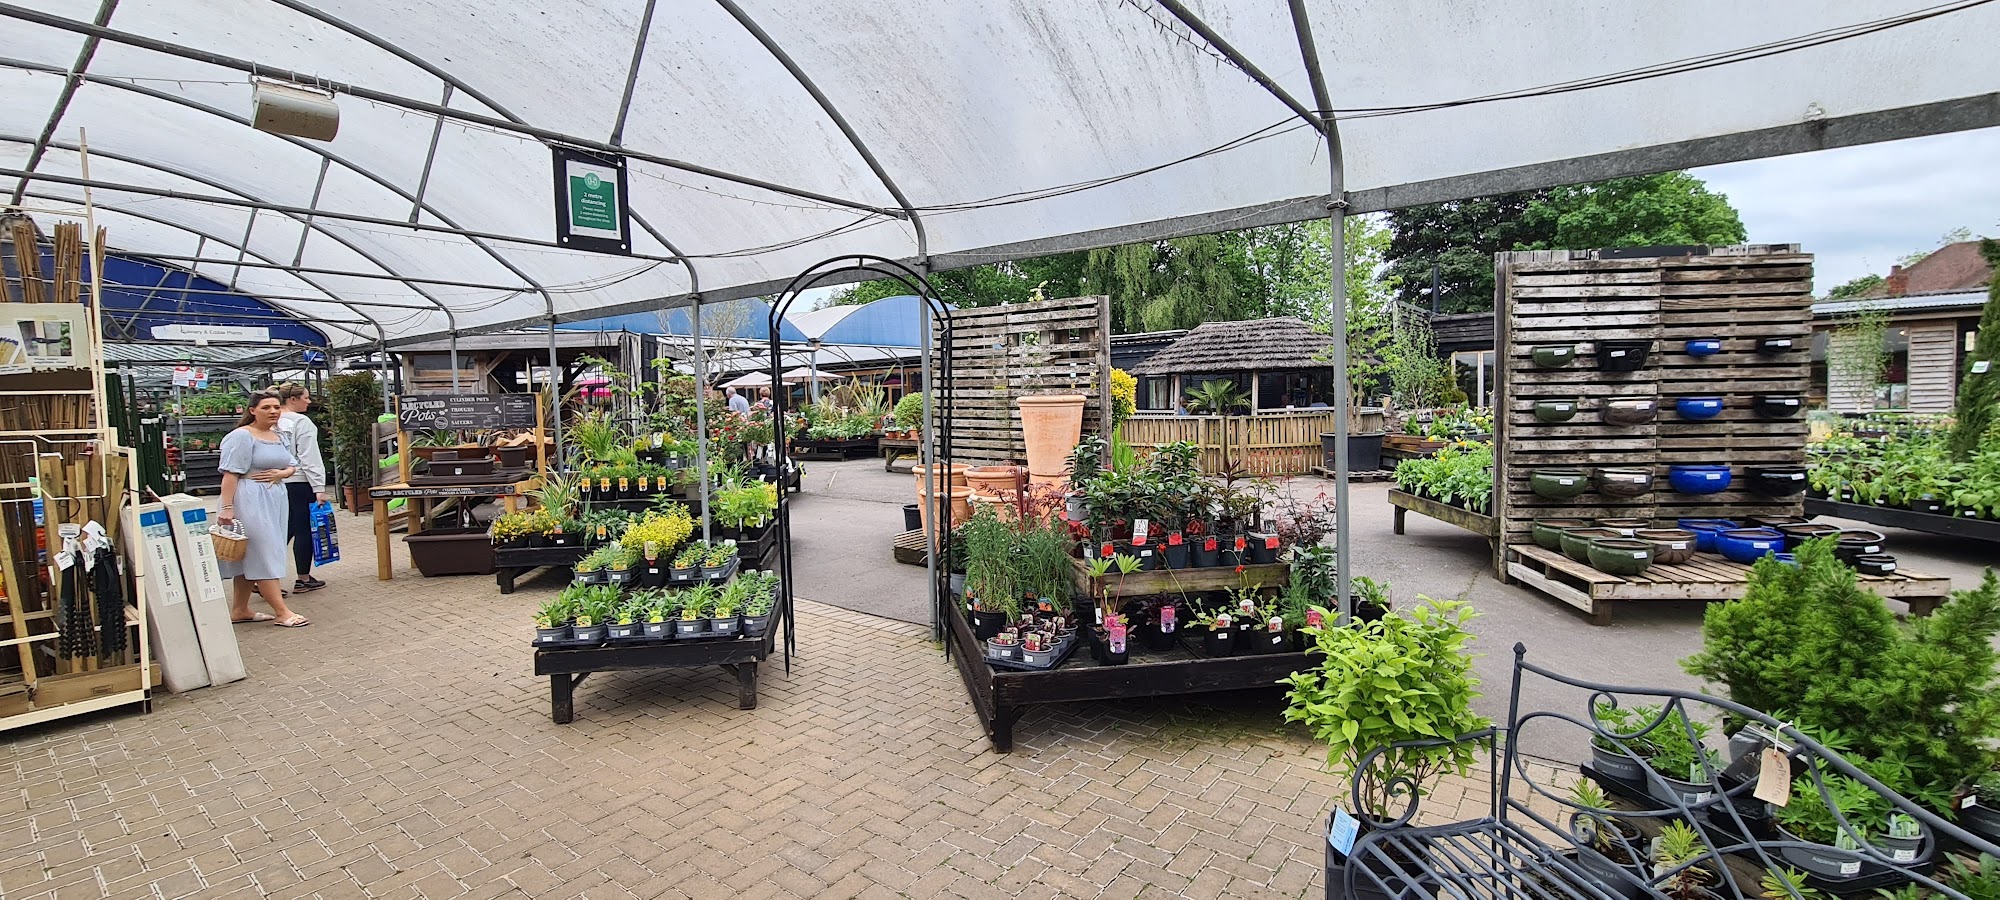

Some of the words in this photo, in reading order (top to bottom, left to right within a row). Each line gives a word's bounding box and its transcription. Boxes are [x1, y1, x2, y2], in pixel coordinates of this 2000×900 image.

[581, 198, 606, 207] distancing
[401, 400, 446, 410] RECYCLED
[400, 409, 437, 425] Pots
[162, 564, 171, 586] TONNELLE
[201, 561, 209, 582] TONNELLE
